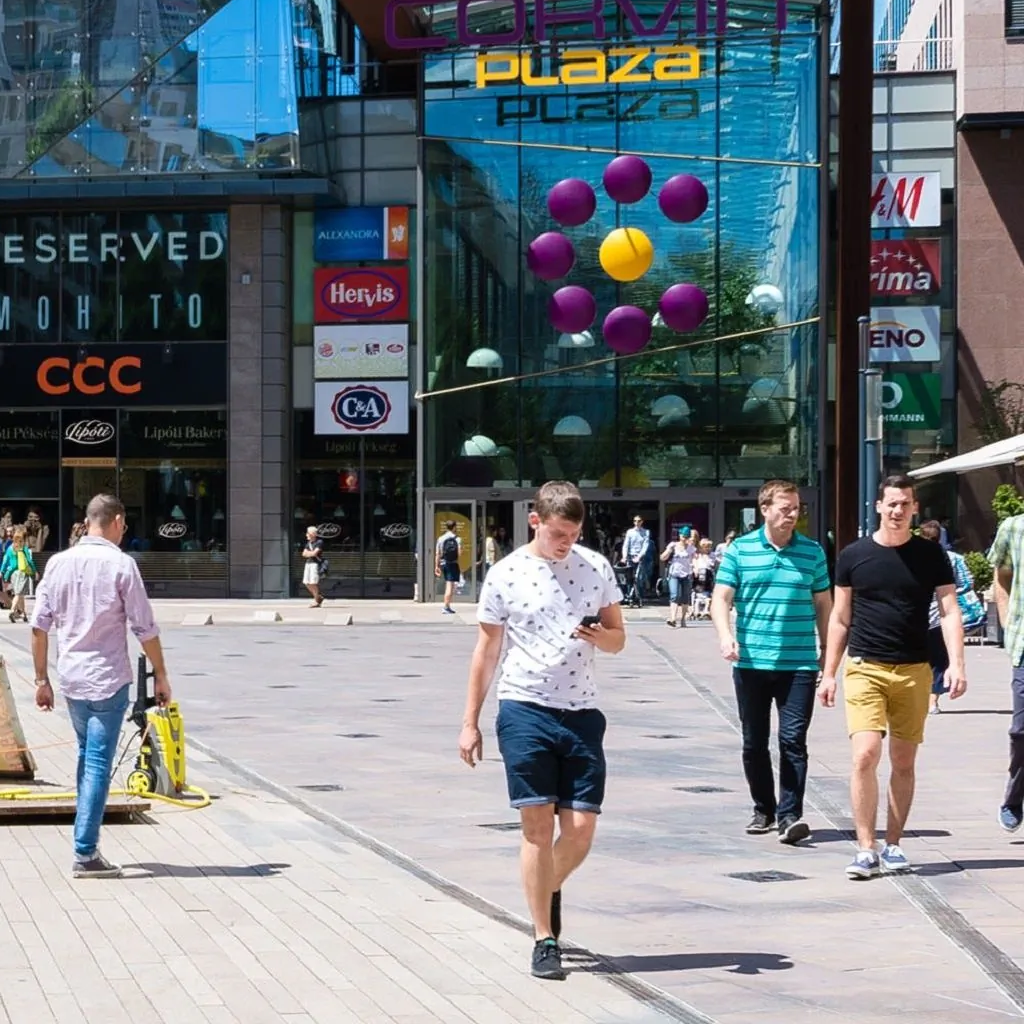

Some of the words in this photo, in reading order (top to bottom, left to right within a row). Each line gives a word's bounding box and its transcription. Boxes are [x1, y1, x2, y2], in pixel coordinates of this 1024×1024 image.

[317, 229, 380, 241] ALEXANDRA
[871, 267, 932, 292] ríma
[330, 282, 396, 307] Hervis
[869, 328, 926, 350] ENO
[36, 356, 142, 395] CCC
[342, 396, 382, 418] C&A
